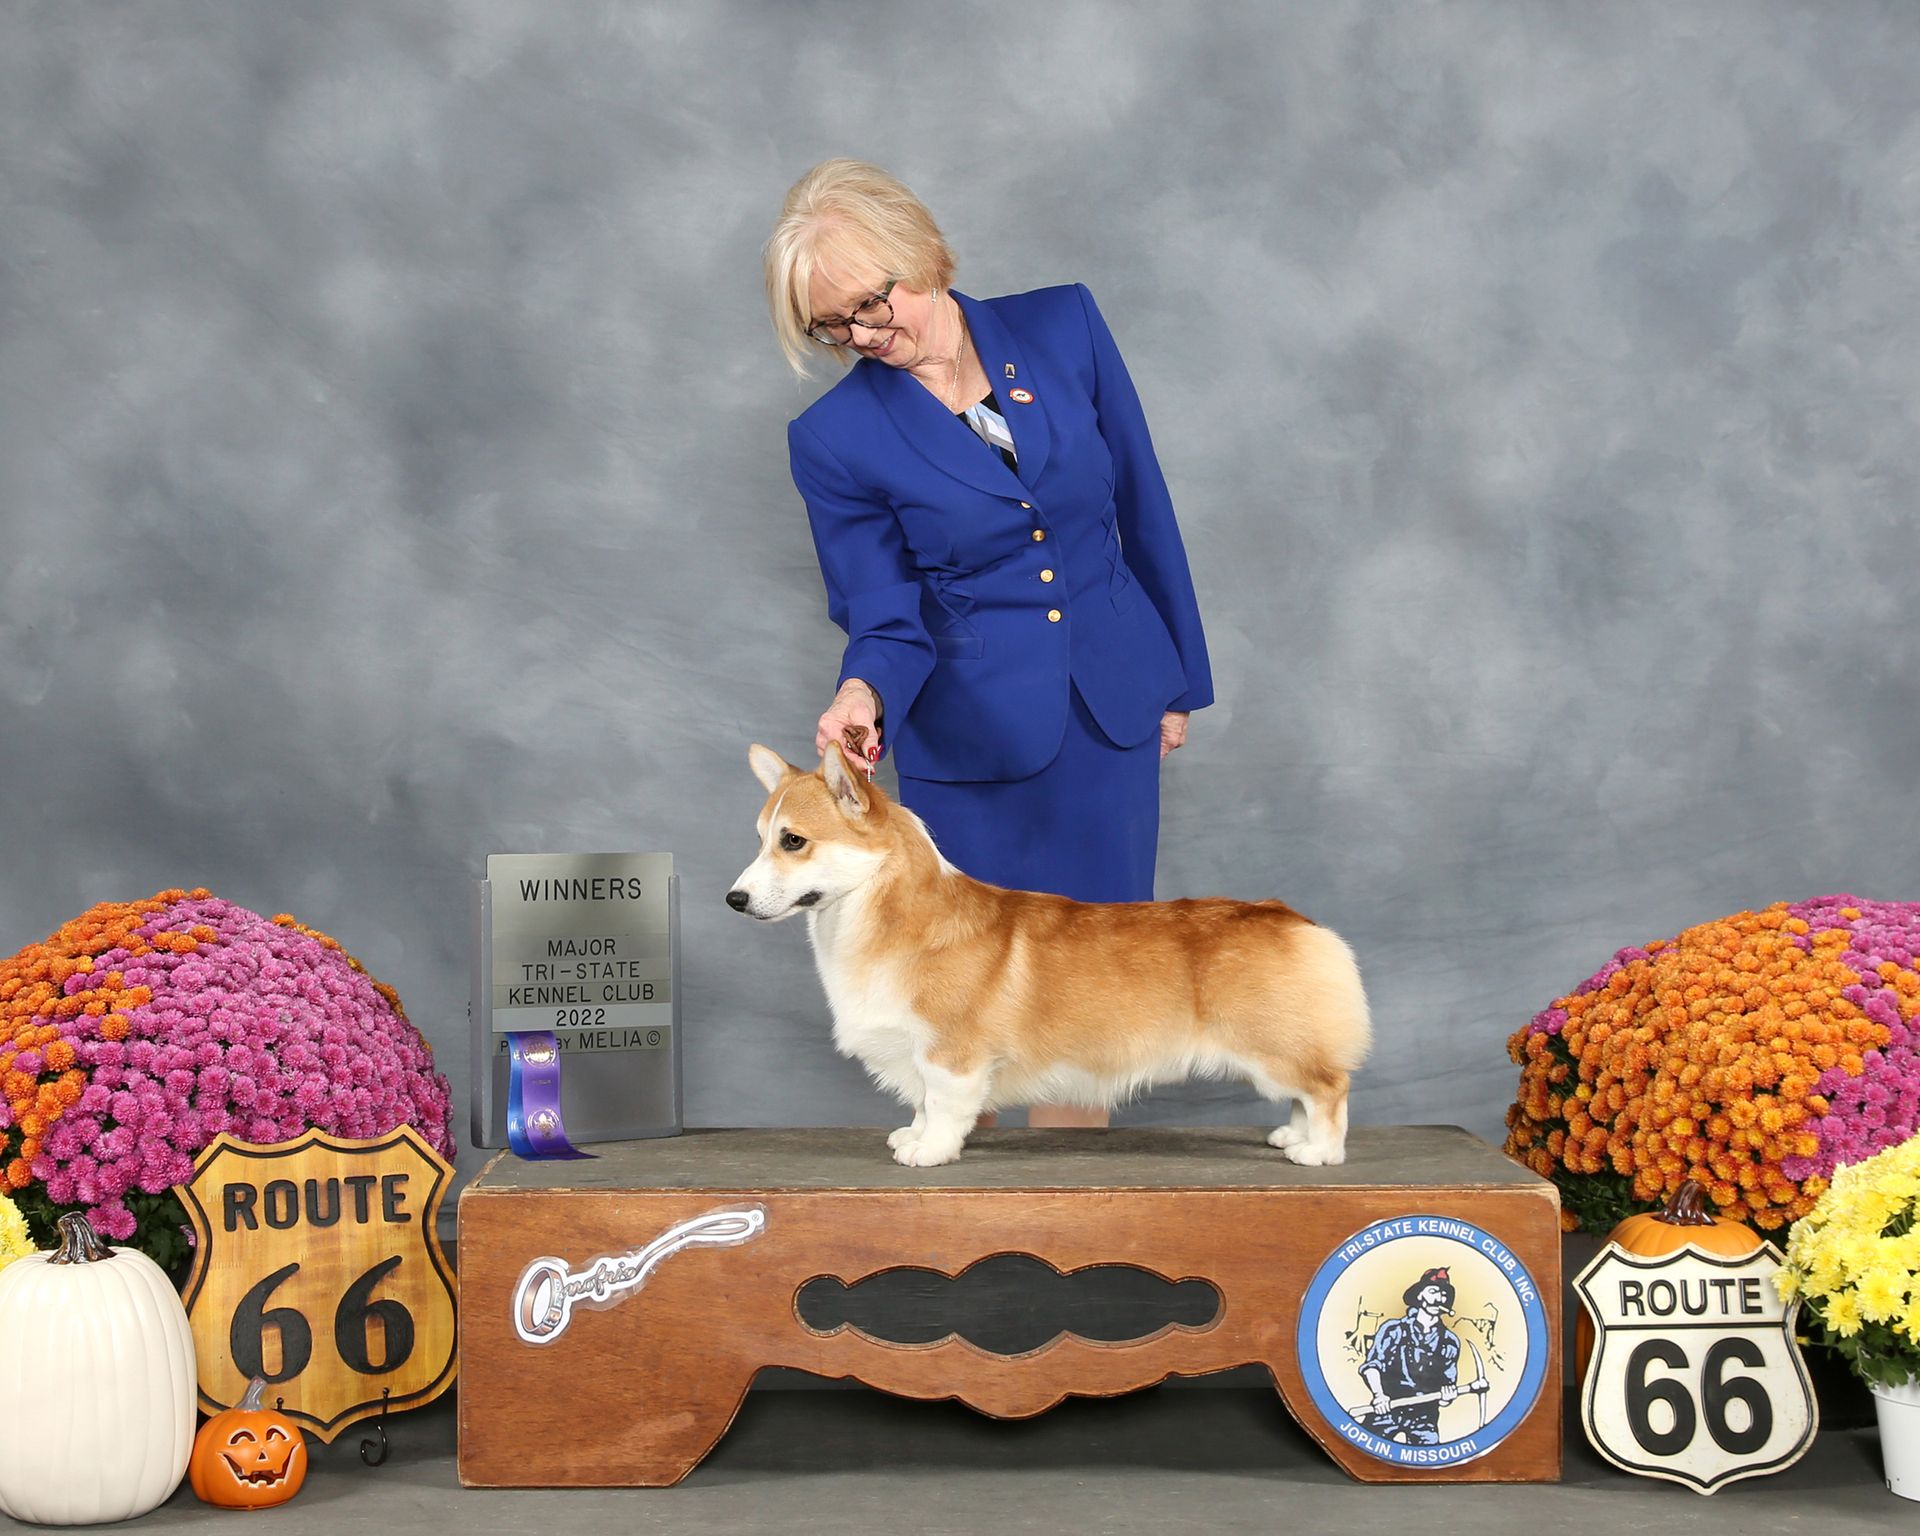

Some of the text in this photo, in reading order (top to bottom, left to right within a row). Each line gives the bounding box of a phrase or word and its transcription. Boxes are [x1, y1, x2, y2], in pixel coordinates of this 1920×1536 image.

[520, 877, 642, 901] WINNERS
[548, 939, 616, 956] MAJOR
[522, 961, 640, 981] TRI-STATE
[509, 984, 654, 1004] KENNEL CLUB
[556, 1009, 606, 1026] 2022
[223, 1174, 411, 1232] ROUTE
[1338, 1221, 1412, 1262] TRI-STATE
[1418, 1220, 1475, 1243] KENNEL
[1514, 1276, 1534, 1307] INC.
[1619, 1278, 1763, 1317] ROUTE
[230, 1255, 415, 1384] 66
[1624, 1337, 1773, 1456] 66
[1340, 1422, 1477, 1462] JOPLIN, MISSOURI
